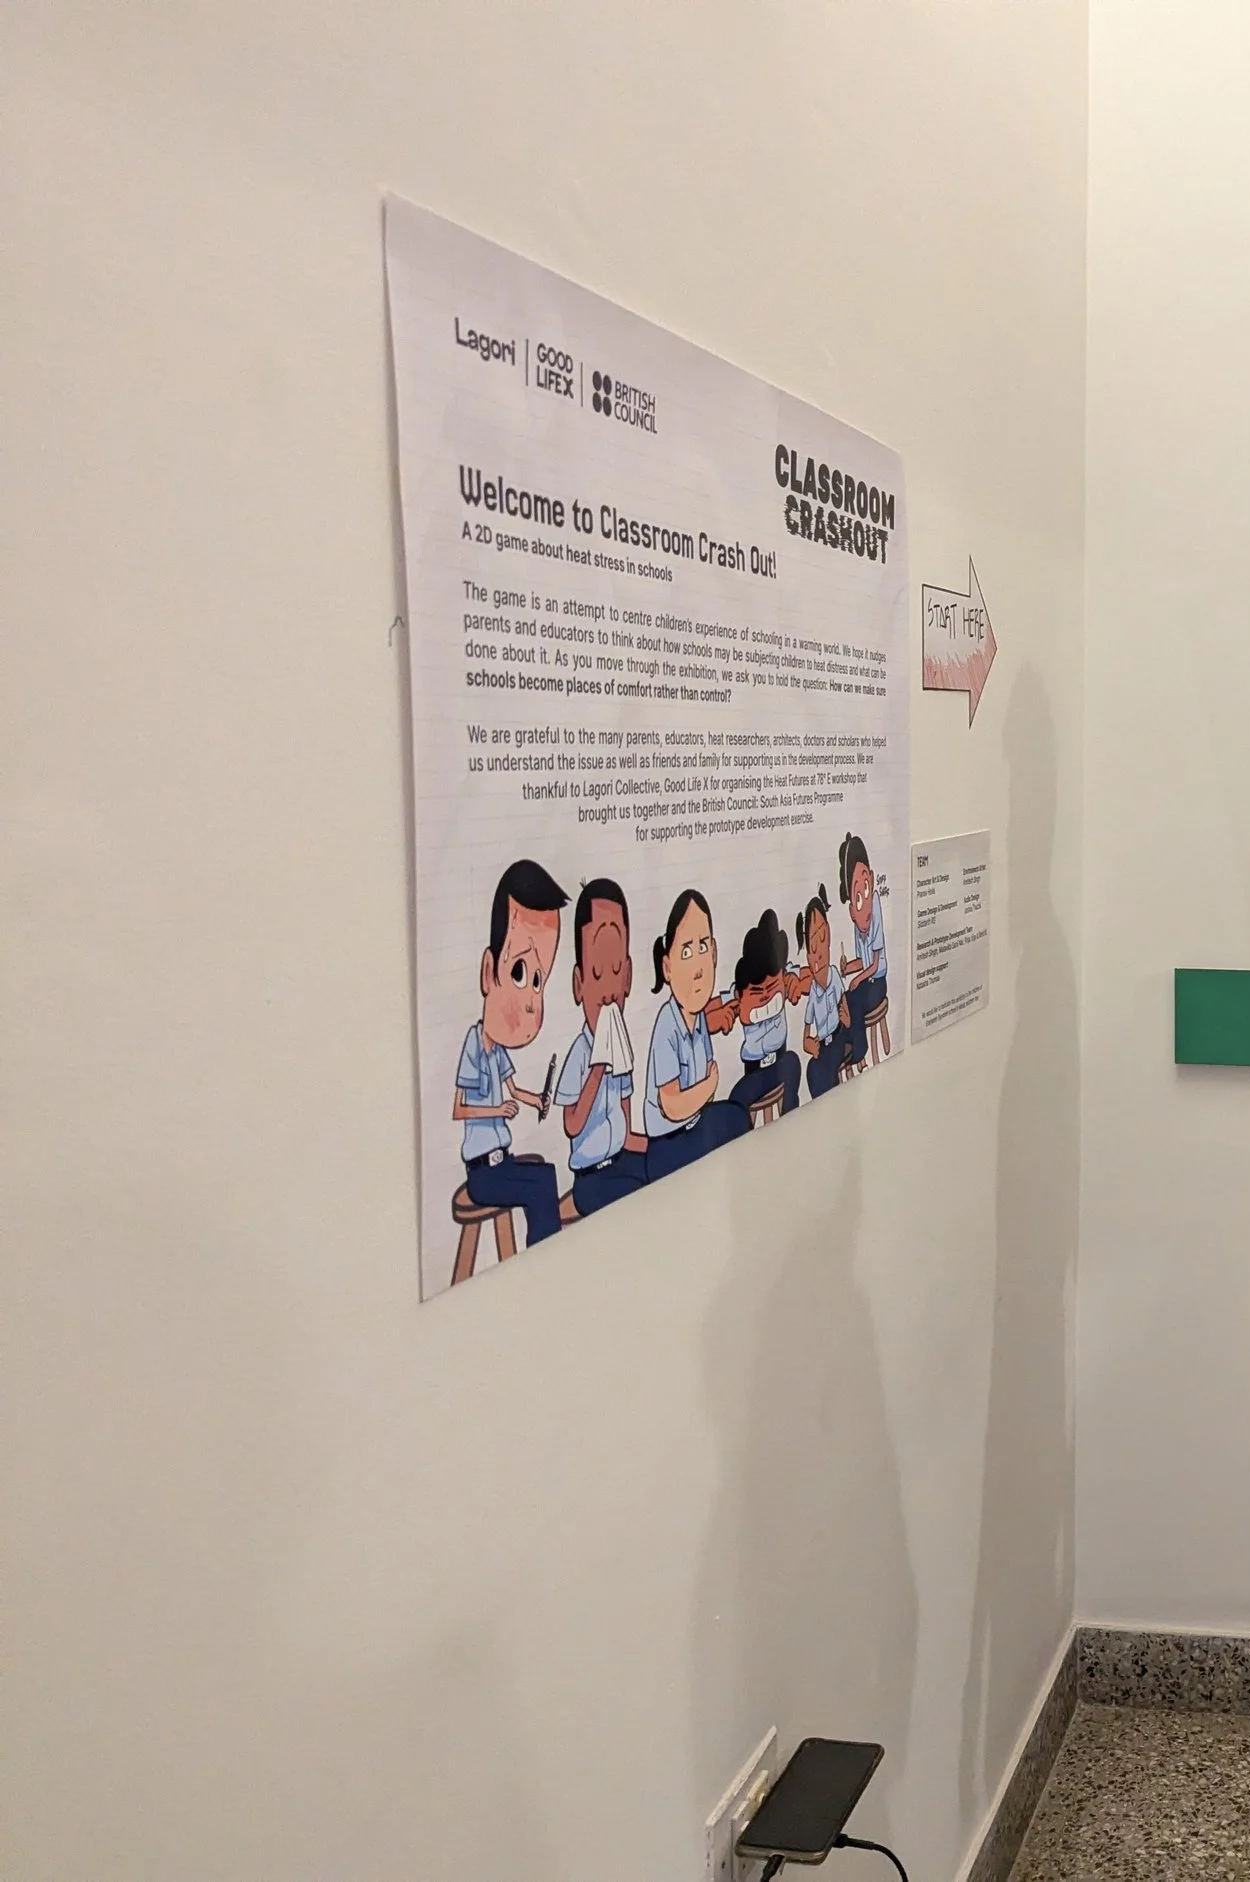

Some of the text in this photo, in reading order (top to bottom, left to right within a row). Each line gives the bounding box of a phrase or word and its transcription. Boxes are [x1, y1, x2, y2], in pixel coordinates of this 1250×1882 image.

[455, 317, 515, 366] Lagori
[537, 343, 573, 373] GOOD
[537, 365, 574, 399] LIFEX
[615, 381, 656, 413] BRITISH
[615, 402, 657, 434] COUNCIL
[775, 444, 895, 530] CLASSROOM
[459, 464, 777, 579] Welcome to Classroom Crash Out!
[784, 494, 888, 564] CRASHOUT
[462, 521, 673, 582] A 2D game about heat stress in schools
[463, 580, 797, 650] The game is an attempt to centre children's experience of schooling in a
[928, 598, 984, 644] START HERE
[464, 613, 848, 675] parents and educators to think about how schools may be subjecting children to heat distress
[465, 639, 497, 660] done
[503, 643, 535, 664] about
[540, 646, 552, 666] it.
[555, 649, 569, 667] As
[573, 654, 592, 671] you
[596, 656, 624, 672] move
[627, 657, 660, 678] through
[663, 660, 675, 676] the
[679, 664, 718, 683] exhibition,
[721, 669, 733, 682] we
[735, 669, 749, 683] ask
[752, 675, 767, 688] you
[768, 673, 775, 686] to
[775, 673, 789, 688] hold
[790, 675, 801, 689] the
[829, 680, 842, 693] How
[466, 669, 731, 703] schools become places of comfort rather than control?
[467, 724, 488, 744] We
[492, 728, 511, 743] are
[515, 726, 560, 749] grateful
[564, 728, 575, 745] to
[579, 727, 596, 745] the
[599, 731, 624, 749] many
[627, 730, 663, 749] parents,
[665, 730, 706, 748] educators,
[708, 731, 725, 747] heat
[726, 731, 772, 749] researchers,
[803, 733, 825, 747] doctors
[826, 733, 837, 747] and
[469, 757, 484, 772] us
[487, 753, 554, 771] understand
[558, 753, 576, 770] the
[578, 753, 603, 770] issue
[606, 757, 617, 770] as
[620, 753, 637, 769] well
[640, 757, 650, 769] as
[653, 752, 680, 769] friends
[683, 753, 698, 768] and
[699, 752, 720, 770] family
[721, 752, 732, 768] for
[733, 753, 773, 770] supporting
[774, 757, 781, 767] us
[781, 753, 788, 767] in
[788, 753, 797, 766] the
[798, 752, 833, 768] development
[523, 781, 568, 800] thankful
[570, 782, 580, 798] to
[583, 779, 613, 801] Lagori
[615, 778, 662, 796] Collective,
[664, 778, 686, 792] Good
[687, 776, 702, 791] Life
[703, 776, 709, 790] X
[710, 776, 720, 790] for
[721, 775, 761, 792] organising
[763, 775, 773, 788] the
[774, 774, 788, 788] Heat
[788, 773, 809, 787] Futures
[810, 774, 816, 786] at
[832, 772, 856, 787] workshop
[579, 804, 617, 824] brought
[619, 806, 630, 820] us
[633, 801, 670, 821] together
[671, 803, 686, 816] and
[688, 799, 700, 814] the
[702, 798, 726, 814] British
[760, 794, 779, 809] South
[780, 793, 792, 807] Asia
[793, 793, 813, 807] Futures
[814, 792, 843, 807] Programme
[636, 826, 649, 842] for
[651, 820, 693, 842] supporting
[695, 818, 707, 836] the
[709, 817, 745, 836] prototype
[747, 812, 790, 831] development
[917, 855, 929, 868] TEAM
